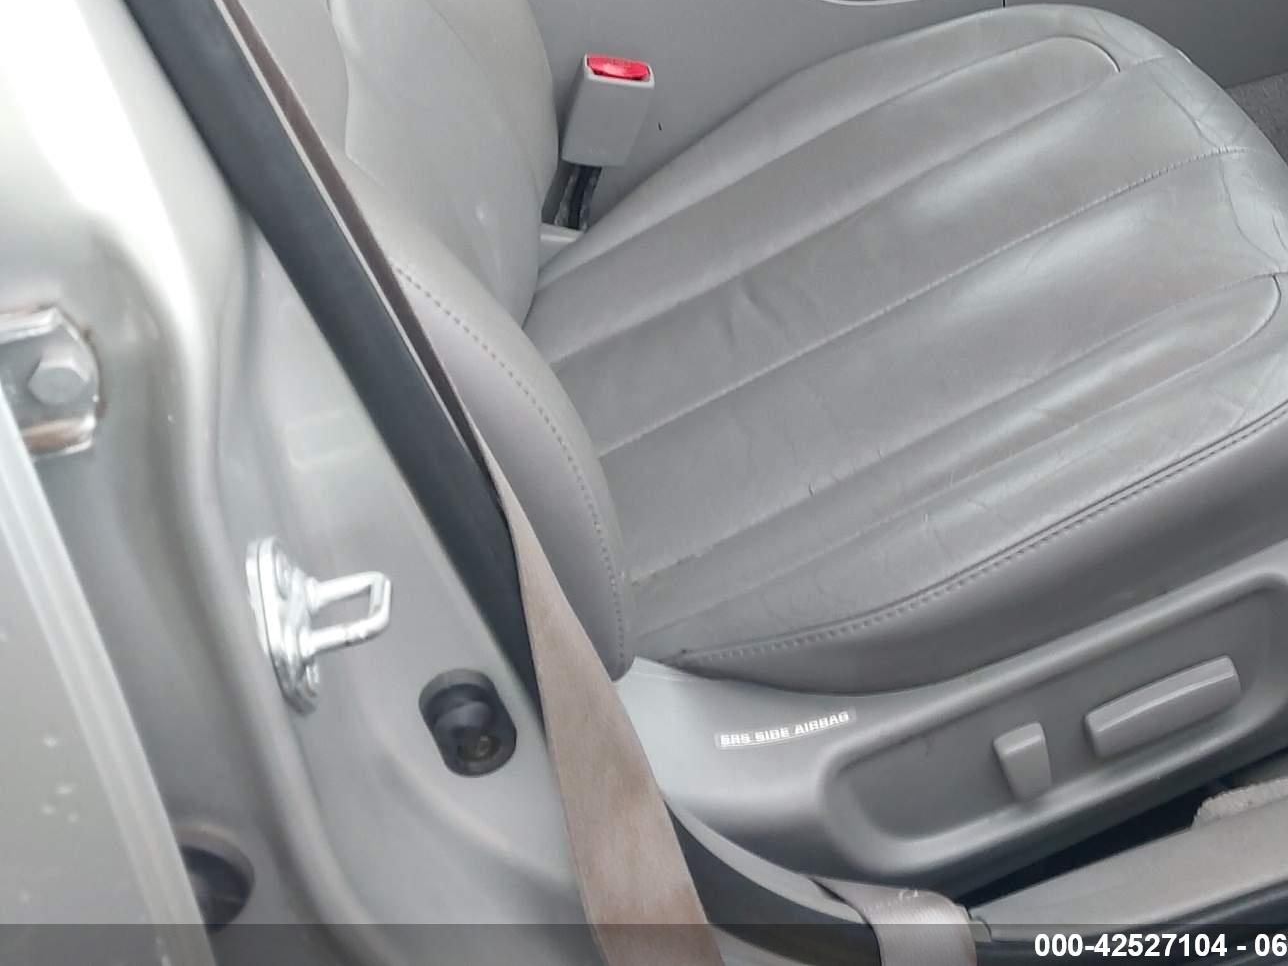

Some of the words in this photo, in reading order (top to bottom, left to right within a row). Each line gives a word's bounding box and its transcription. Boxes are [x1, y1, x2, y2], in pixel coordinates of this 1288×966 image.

[720, 733, 752, 747] SRS
[755, 726, 790, 743] SIDE
[794, 710, 849, 735] AIRBAG
